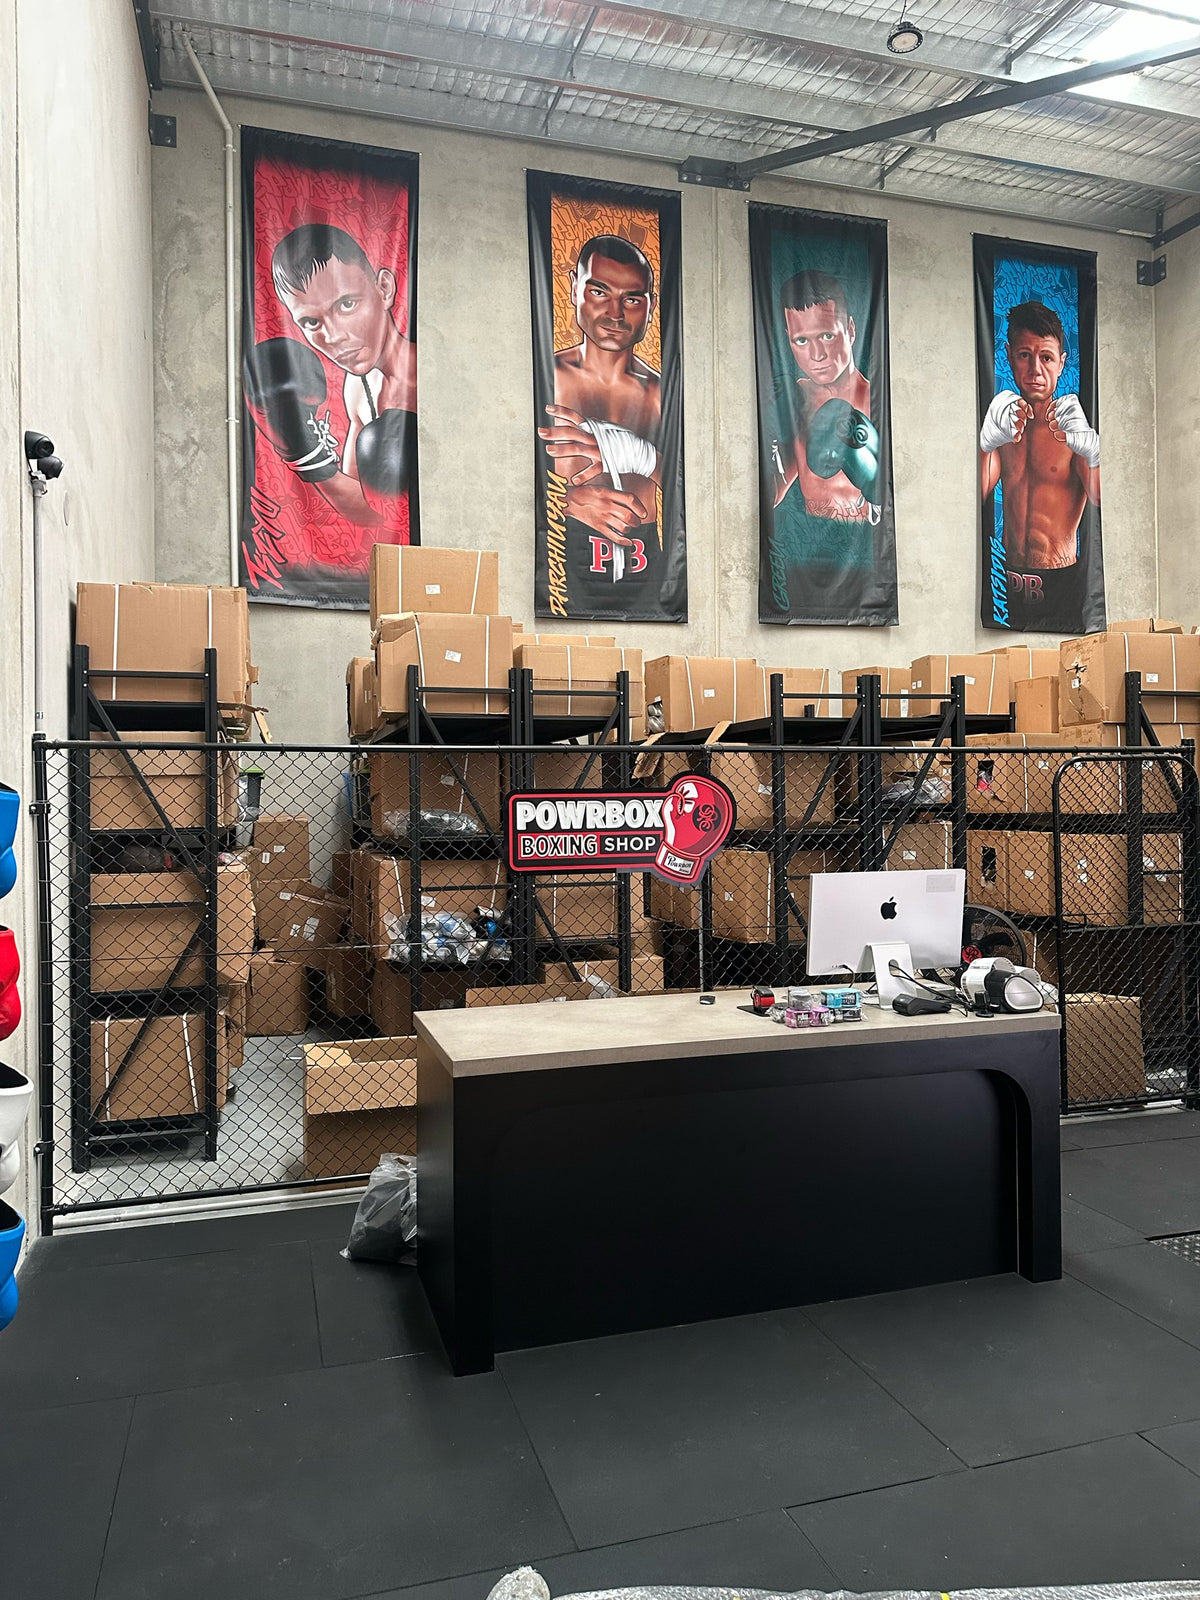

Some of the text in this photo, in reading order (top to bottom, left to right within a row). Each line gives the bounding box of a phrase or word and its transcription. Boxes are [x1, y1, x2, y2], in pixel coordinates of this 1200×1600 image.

[546, 469, 569, 617] DARCHINYAN
[768, 536, 790, 611] GREEN
[989, 535, 1011, 628] KATSIDIS
[516, 799, 664, 831] POWRBOX
[520, 835, 656, 857] BOXING SHOP
